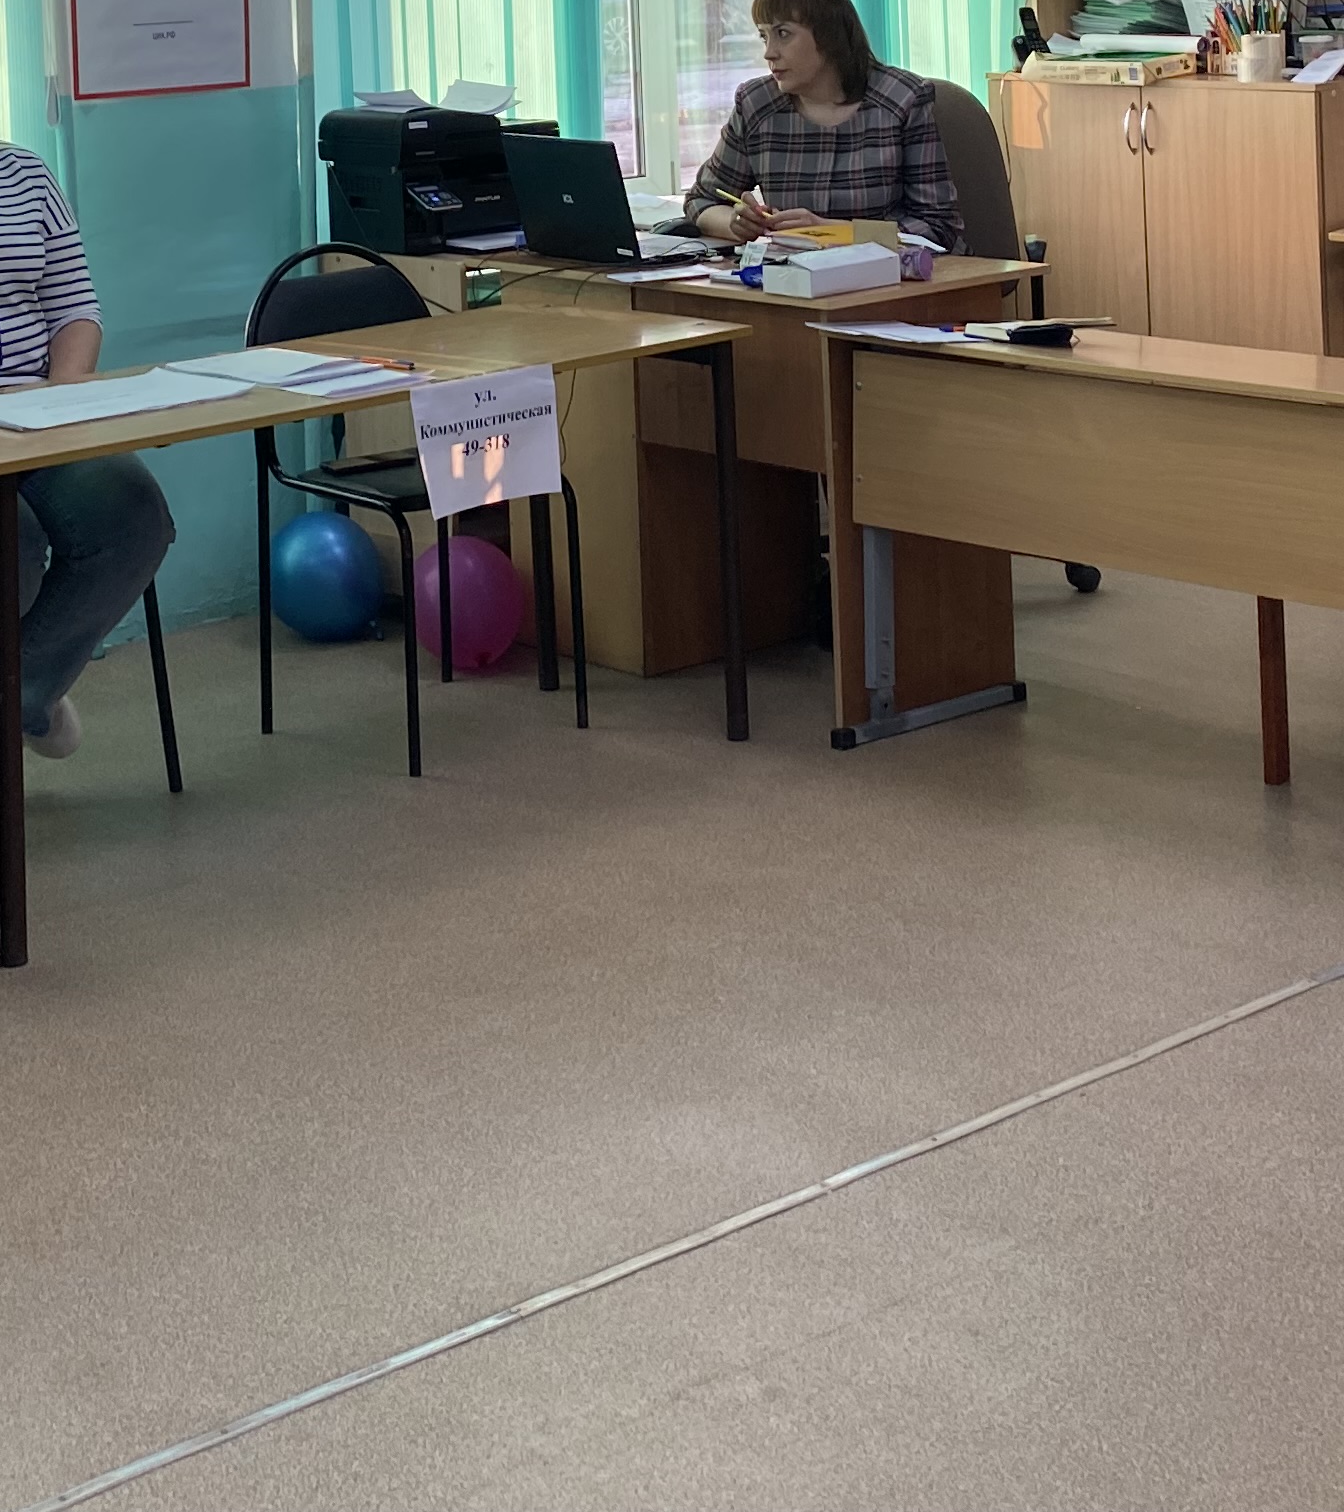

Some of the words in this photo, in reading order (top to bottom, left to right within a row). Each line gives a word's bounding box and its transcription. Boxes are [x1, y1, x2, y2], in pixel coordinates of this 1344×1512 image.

[474, 390, 497, 408] ул.
[420, 404, 552, 440] Коммунистическая
[462, 433, 510, 457] 49-318
